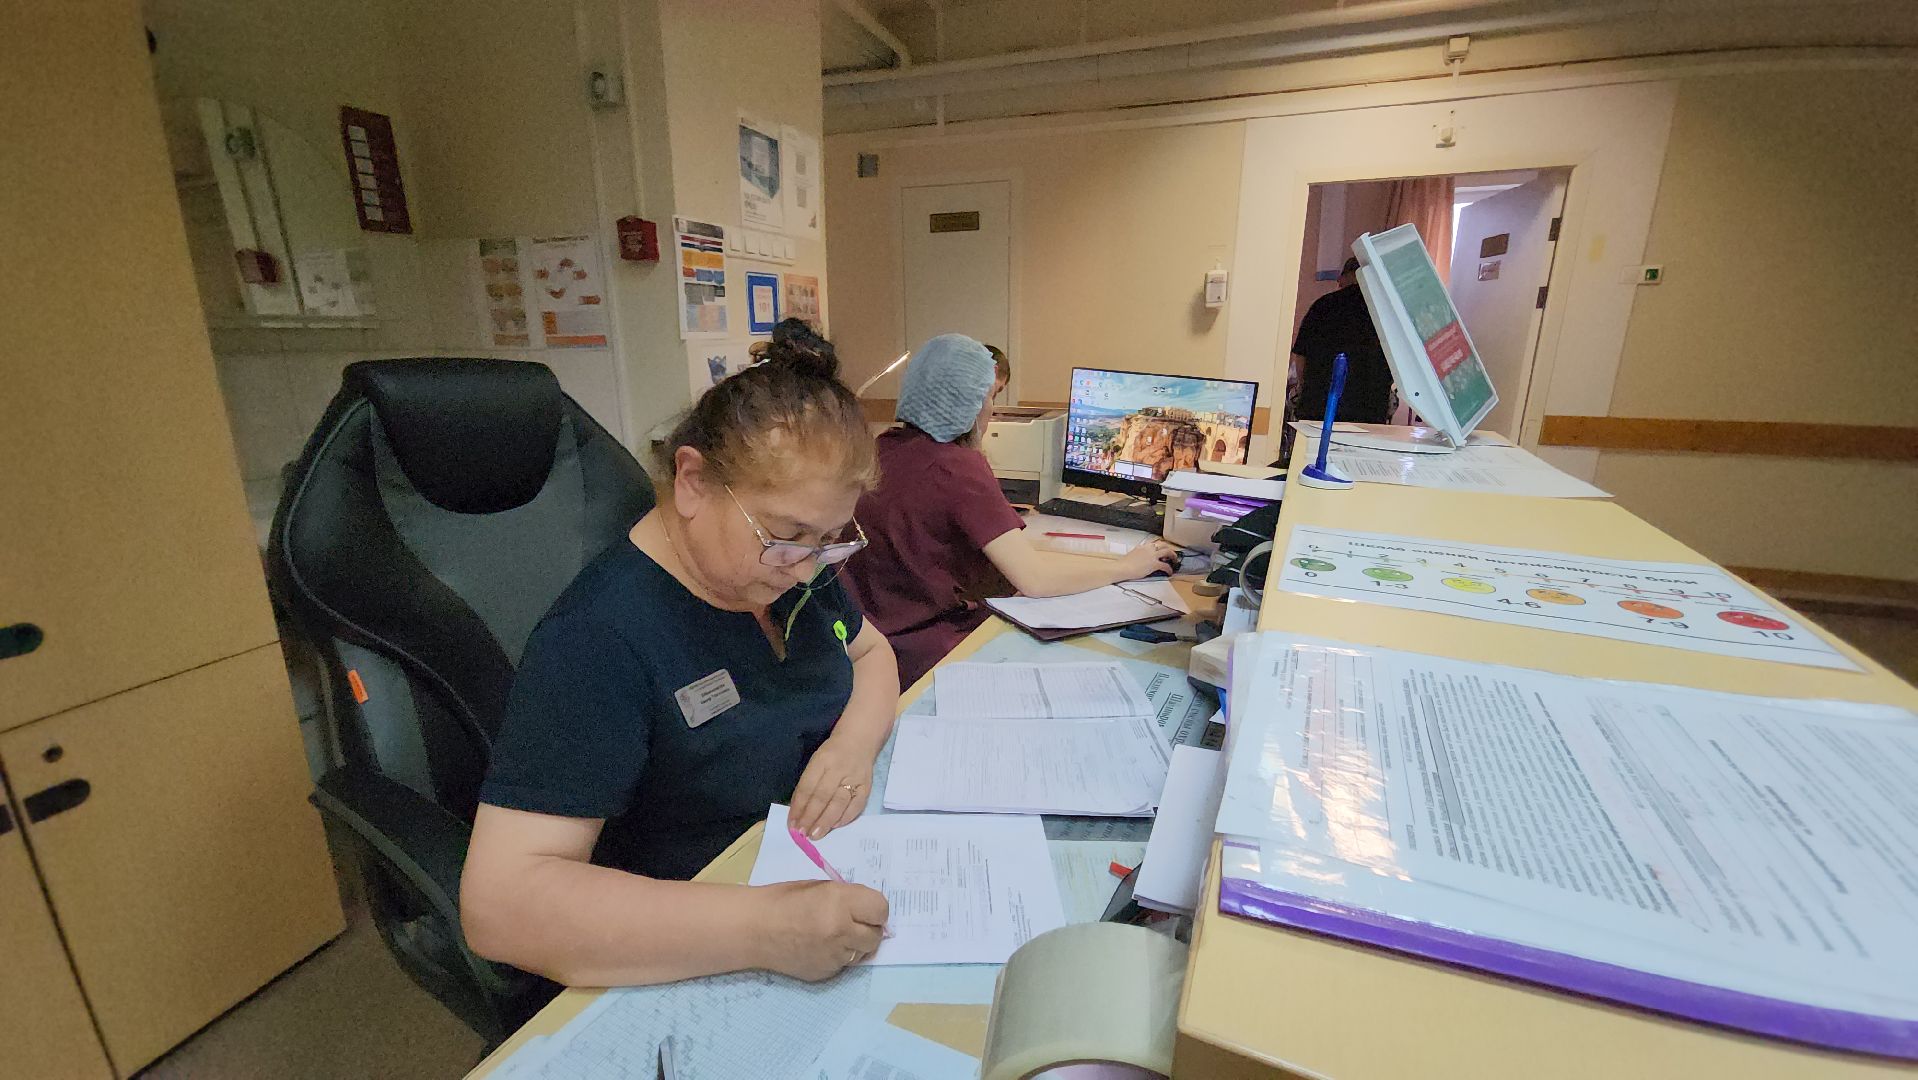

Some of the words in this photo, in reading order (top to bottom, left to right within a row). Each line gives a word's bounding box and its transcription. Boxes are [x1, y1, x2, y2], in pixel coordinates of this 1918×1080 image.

[1370, 580, 1409, 589] 1-3
[1497, 598, 1541, 609] 4-6
[1639, 616, 1689, 629] 7-9
[1752, 630, 1795, 641] 10
[1703, 591, 1733, 599] 10
